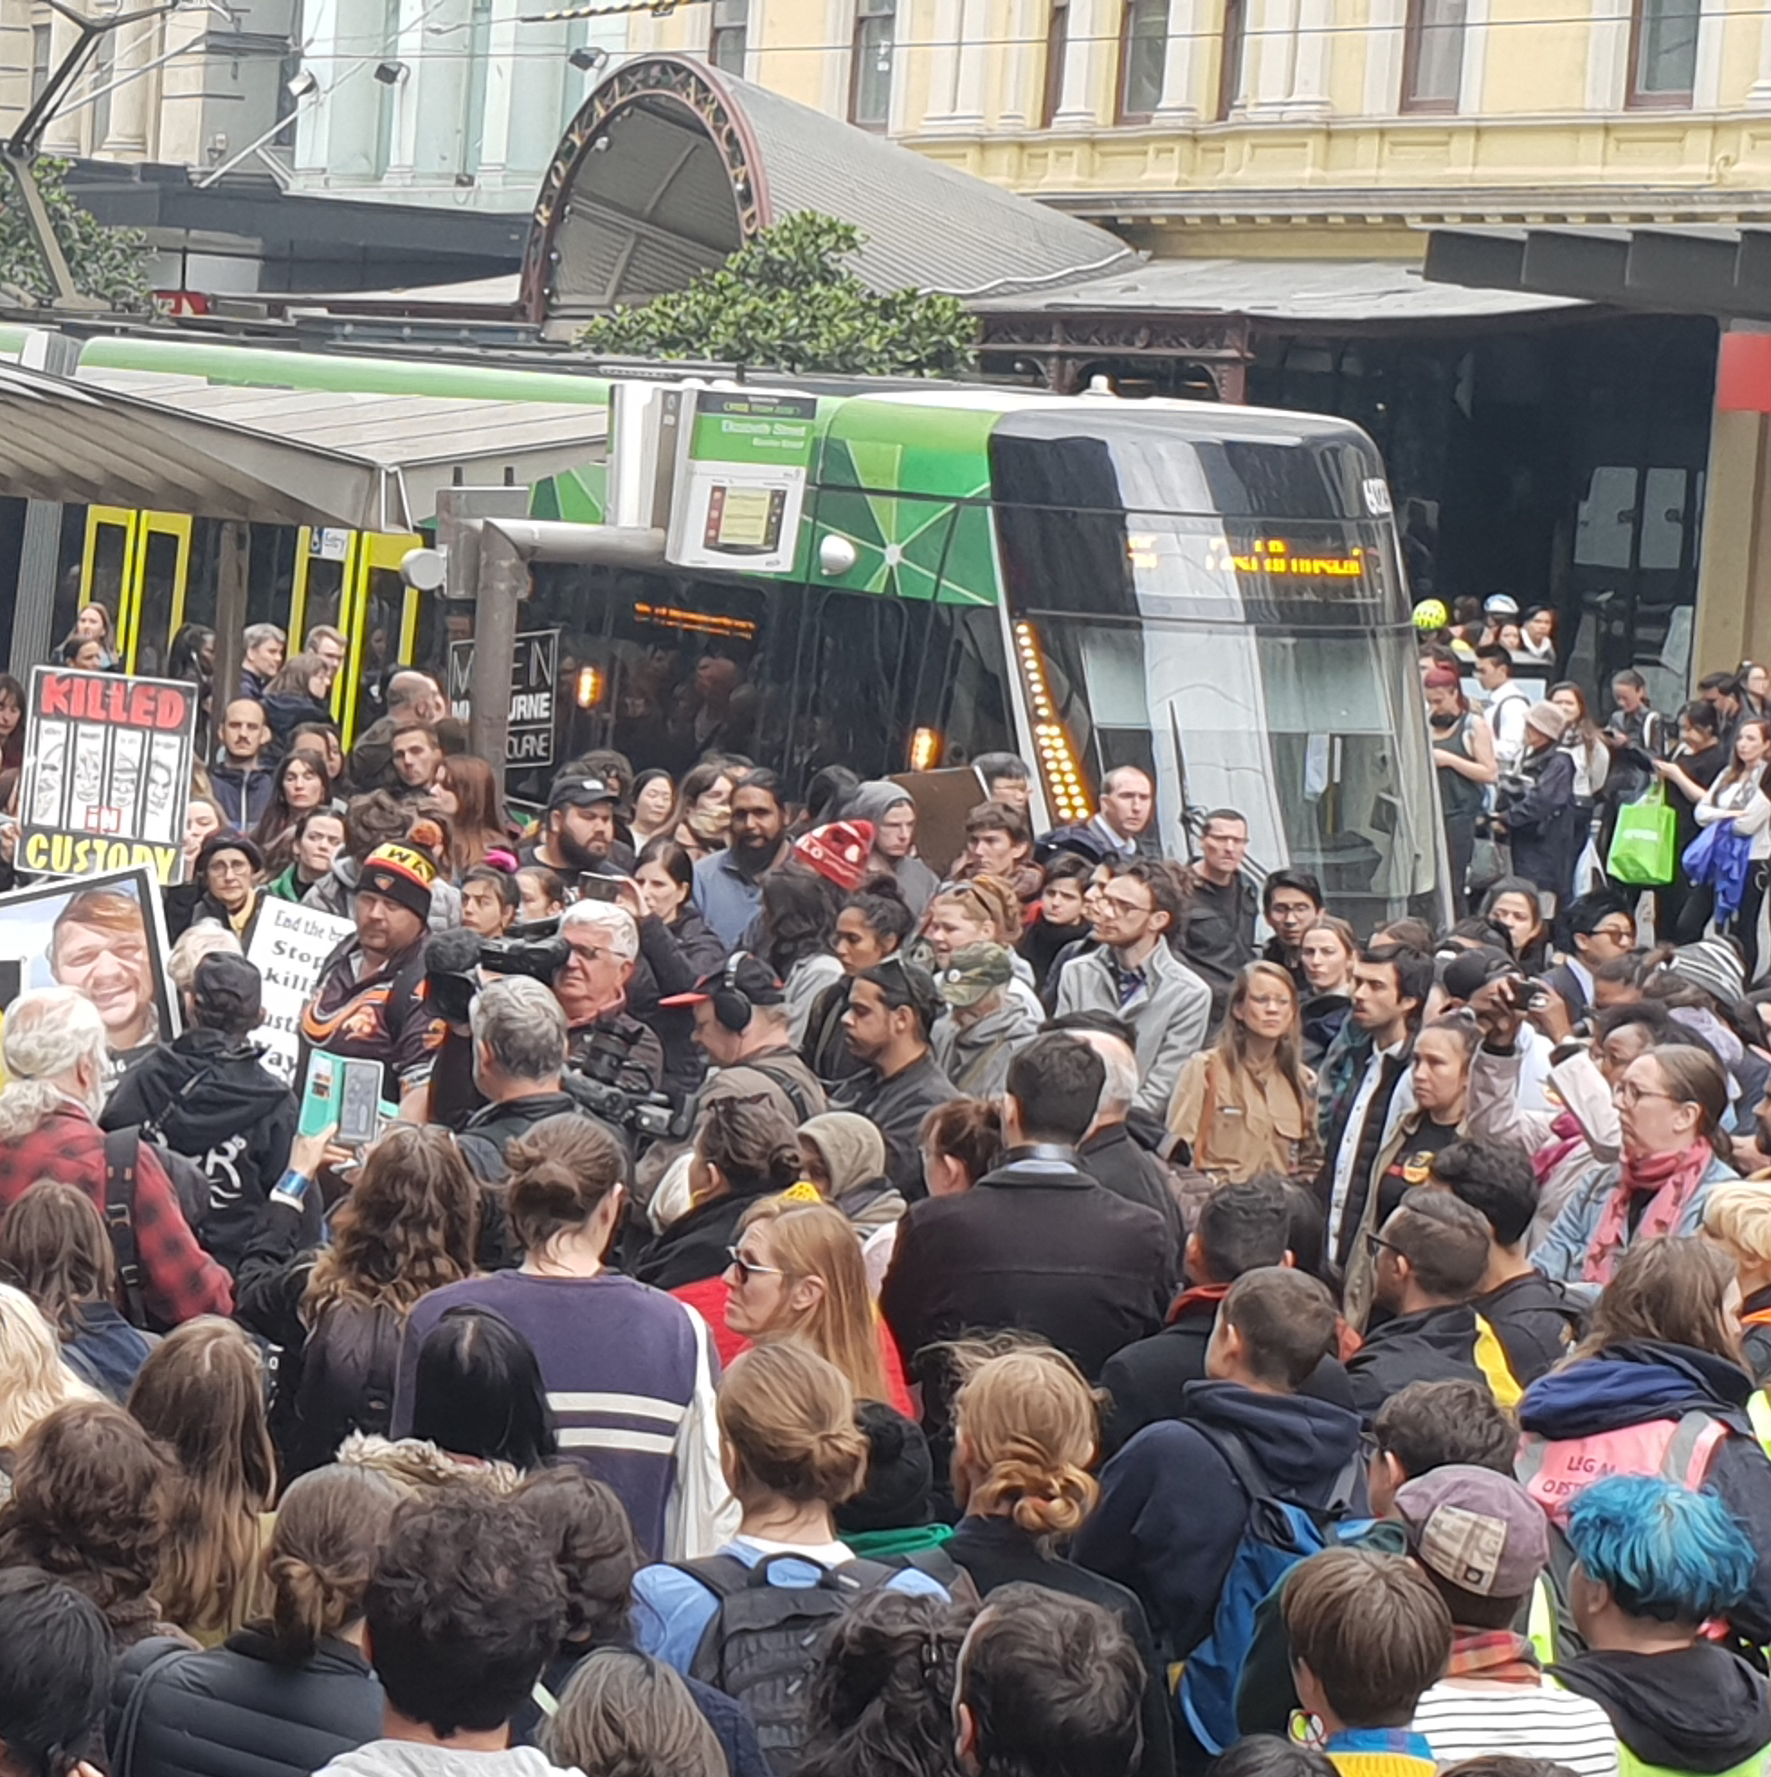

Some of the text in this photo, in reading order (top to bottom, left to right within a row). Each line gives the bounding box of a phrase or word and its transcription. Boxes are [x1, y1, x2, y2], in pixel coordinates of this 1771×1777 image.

[40, 673, 186, 730] KILLED
[26, 833, 177, 886] CUSTODY
[275, 910, 302, 932] End
[304, 919, 326, 939] the
[271, 940, 325, 970] Stop
